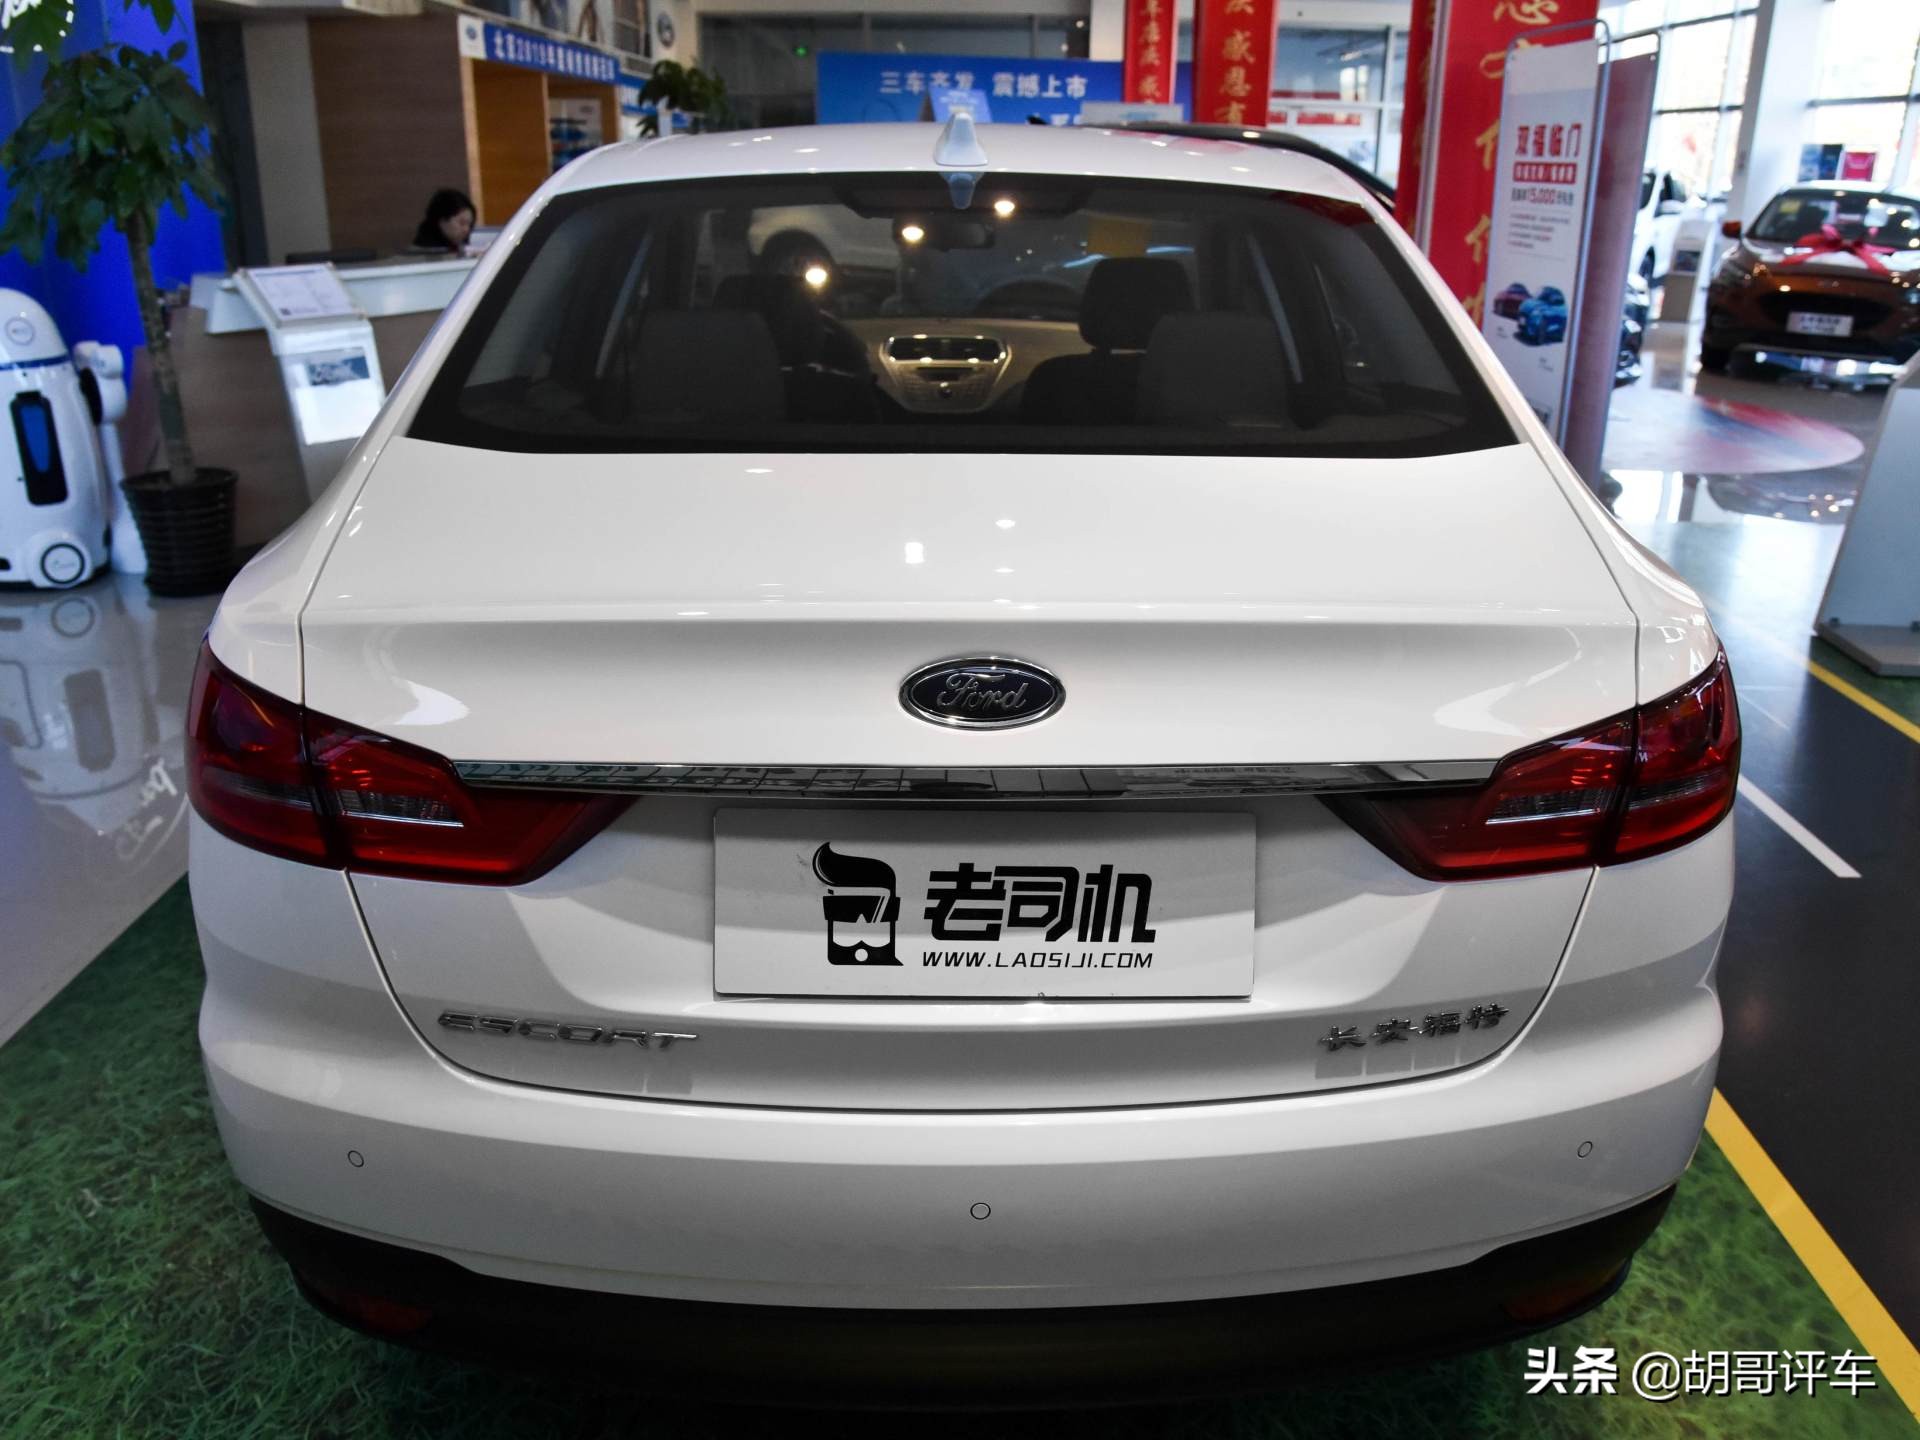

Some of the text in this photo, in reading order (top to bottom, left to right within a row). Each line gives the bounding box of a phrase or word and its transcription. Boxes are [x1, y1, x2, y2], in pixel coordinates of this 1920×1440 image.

[879, 70, 1088, 99] 三车齐发 震撼上市
[1514, 122, 1583, 158] 双福临门
[936, 672, 1030, 711] Ford
[924, 862, 1157, 944] 老司机
[922, 950, 1155, 969] WWW.LAOSIJI.COM
[437, 1009, 699, 1051] ESCORT
[1319, 1002, 1510, 1052] 长安福特
